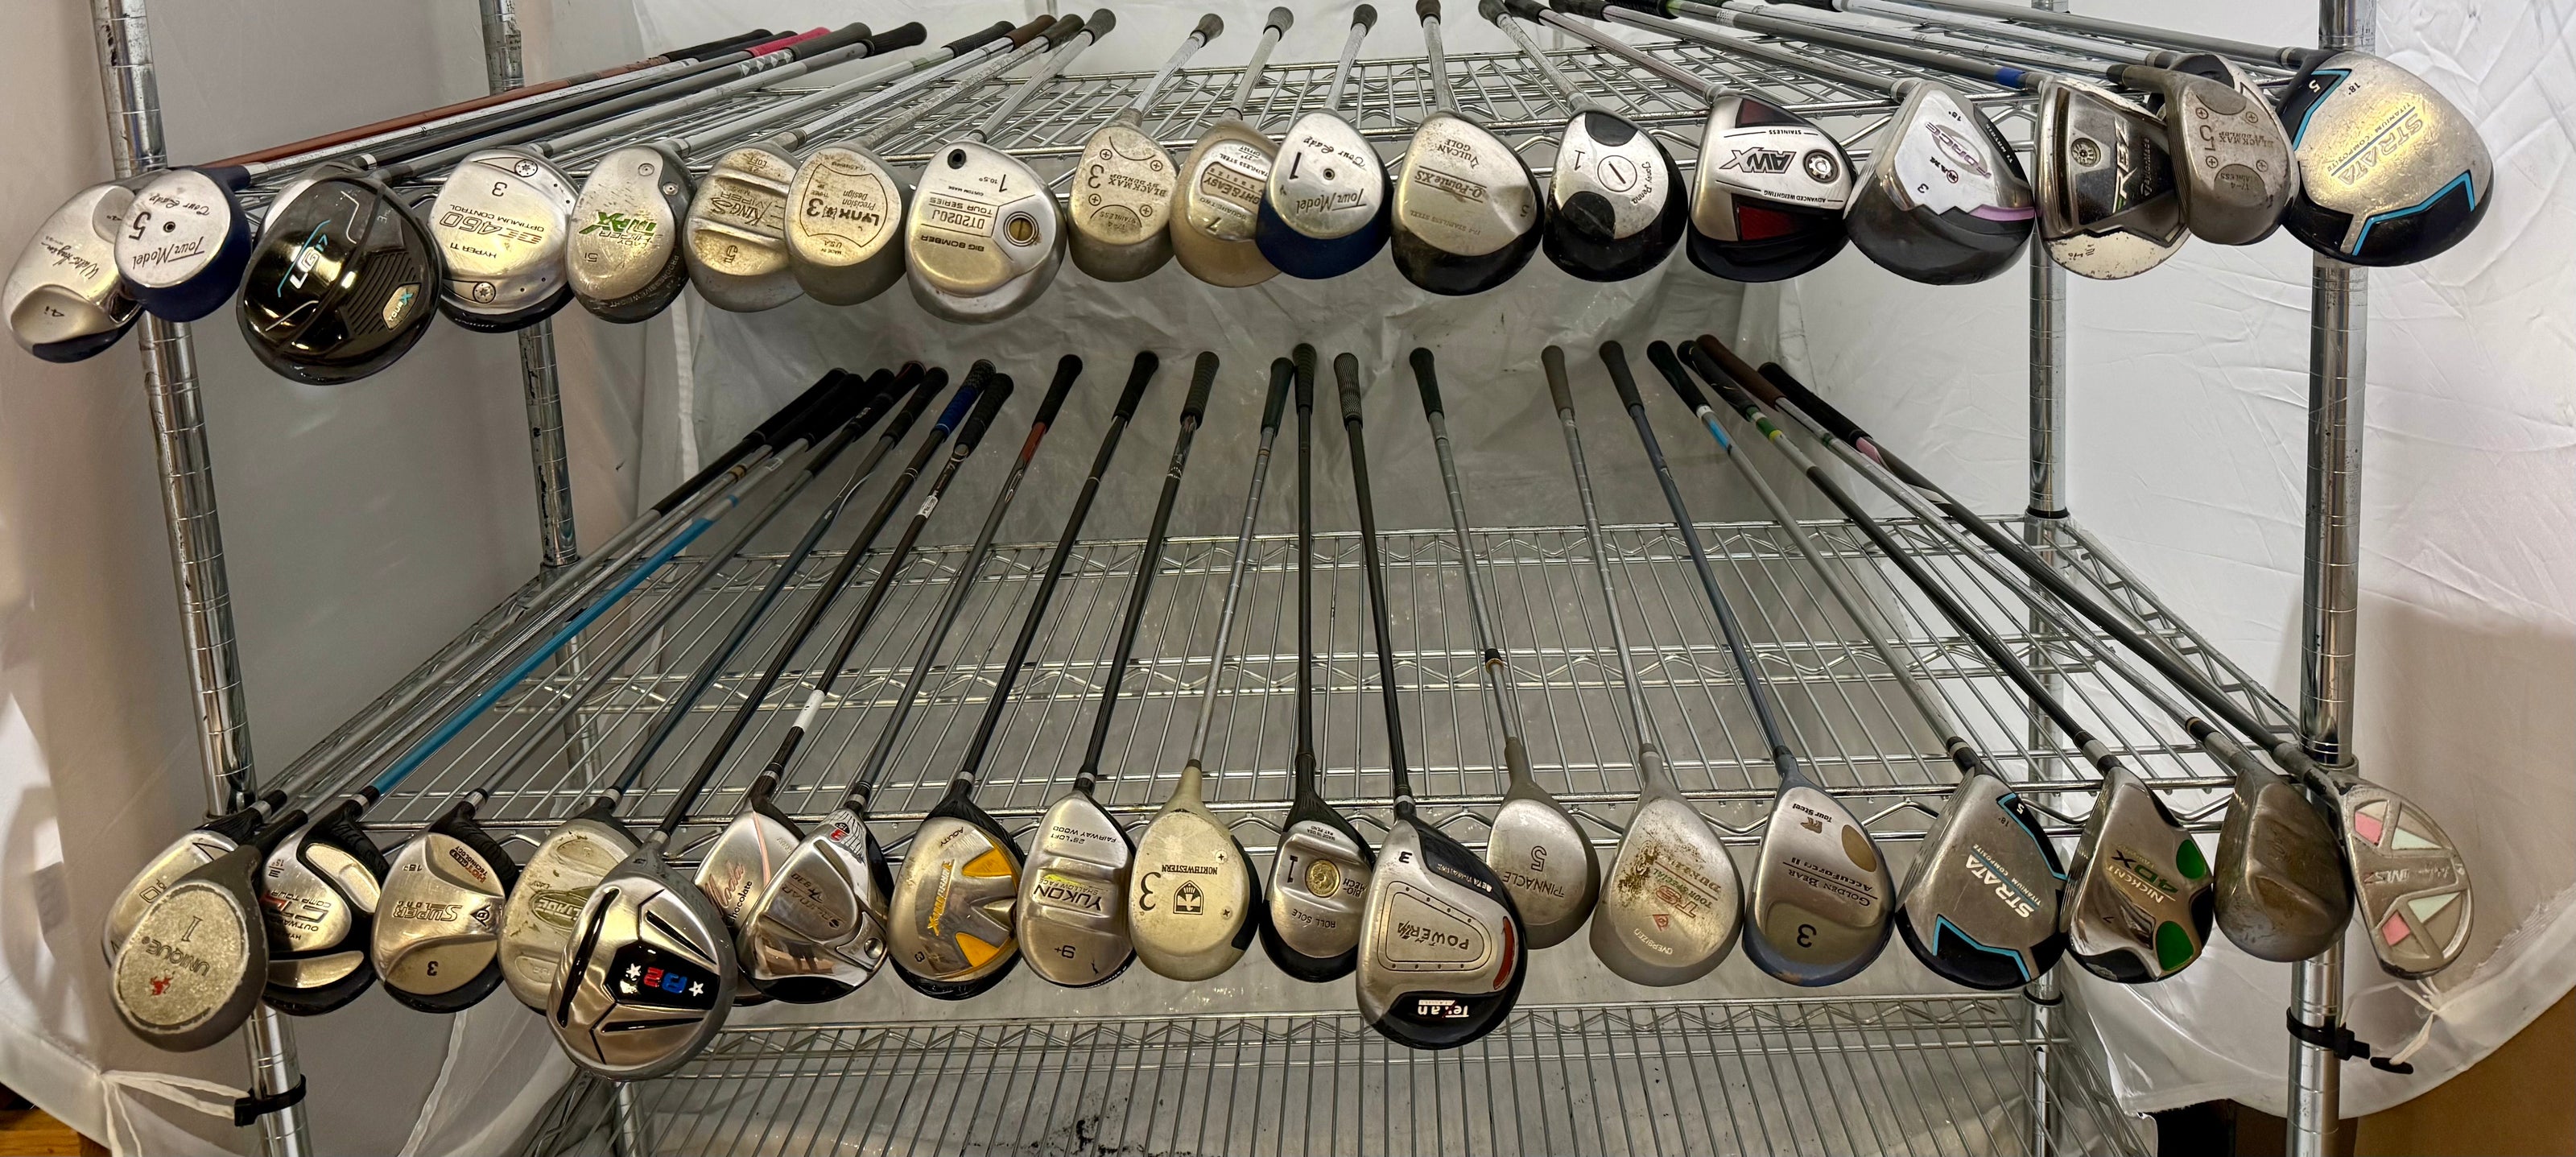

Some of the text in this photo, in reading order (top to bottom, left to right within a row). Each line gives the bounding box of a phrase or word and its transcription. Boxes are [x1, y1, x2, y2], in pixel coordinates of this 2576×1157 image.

[2308, 79, 2321, 93] 5
[2374, 102, 2411, 134] TITANIUM
[1445, 139, 1471, 151] GOLF
[2199, 125, 2215, 151] 5
[1437, 145, 1480, 169] VULCAN
[2337, 113, 2423, 186] STRATA
[1238, 161, 1269, 177] TAINLESS
[1288, 151, 1302, 180] 1
[1574, 150, 1586, 171] 1
[1719, 147, 1797, 174] AWX
[999, 174, 1008, 193] 1
[1088, 164, 1104, 189] 3
[492, 182, 507, 196] 3
[843, 190, 868, 201] Design
[1764, 190, 1827, 204] ADVANCED WEIGHTING
[1918, 184, 1929, 193] 3
[720, 191, 764, 209] VIPER
[807, 198, 824, 217] 3
[842, 199, 876, 210] Precision
[929, 196, 993, 215] TOUR SERIES
[1296, 192, 1337, 214] Model
[129, 212, 151, 242] 5
[450, 205, 544, 233] OPTIMUM CONTROL
[579, 212, 657, 237] MAX
[1205, 217, 1222, 234] 7
[462, 246, 497, 258] HYPER
[920, 235, 985, 252] BIG BOMBER
[133, 244, 174, 269] Model
[724, 246, 738, 263] 5
[2016, 803, 2025, 815] 5
[1053, 826, 1117, 844] FAIRWAY WOOD
[1286, 855, 1298, 883] 1
[1530, 845, 1547, 872] 5
[1161, 864, 1218, 876] NORTHWESTERN
[1972, 843, 2041, 906] TITANIUM COMPOSITE
[1139, 871, 1162, 912] 3
[1343, 878, 1366, 891] MECH
[1502, 871, 1565, 898] PINNACLE
[1789, 869, 1871, 907] GOLDEN BEAR
[1965, 854, 2035, 918] STRATA
[2106, 864, 2165, 903] NICKENT
[1033, 885, 1103, 911] YUKON
[393, 904, 462, 922] SUPER
[1291, 908, 1336, 928] ROLL SOLE
[1633, 928, 1674, 956] OVERSIZED
[1796, 924, 1817, 948] 3
[427, 961, 439, 977] 3
